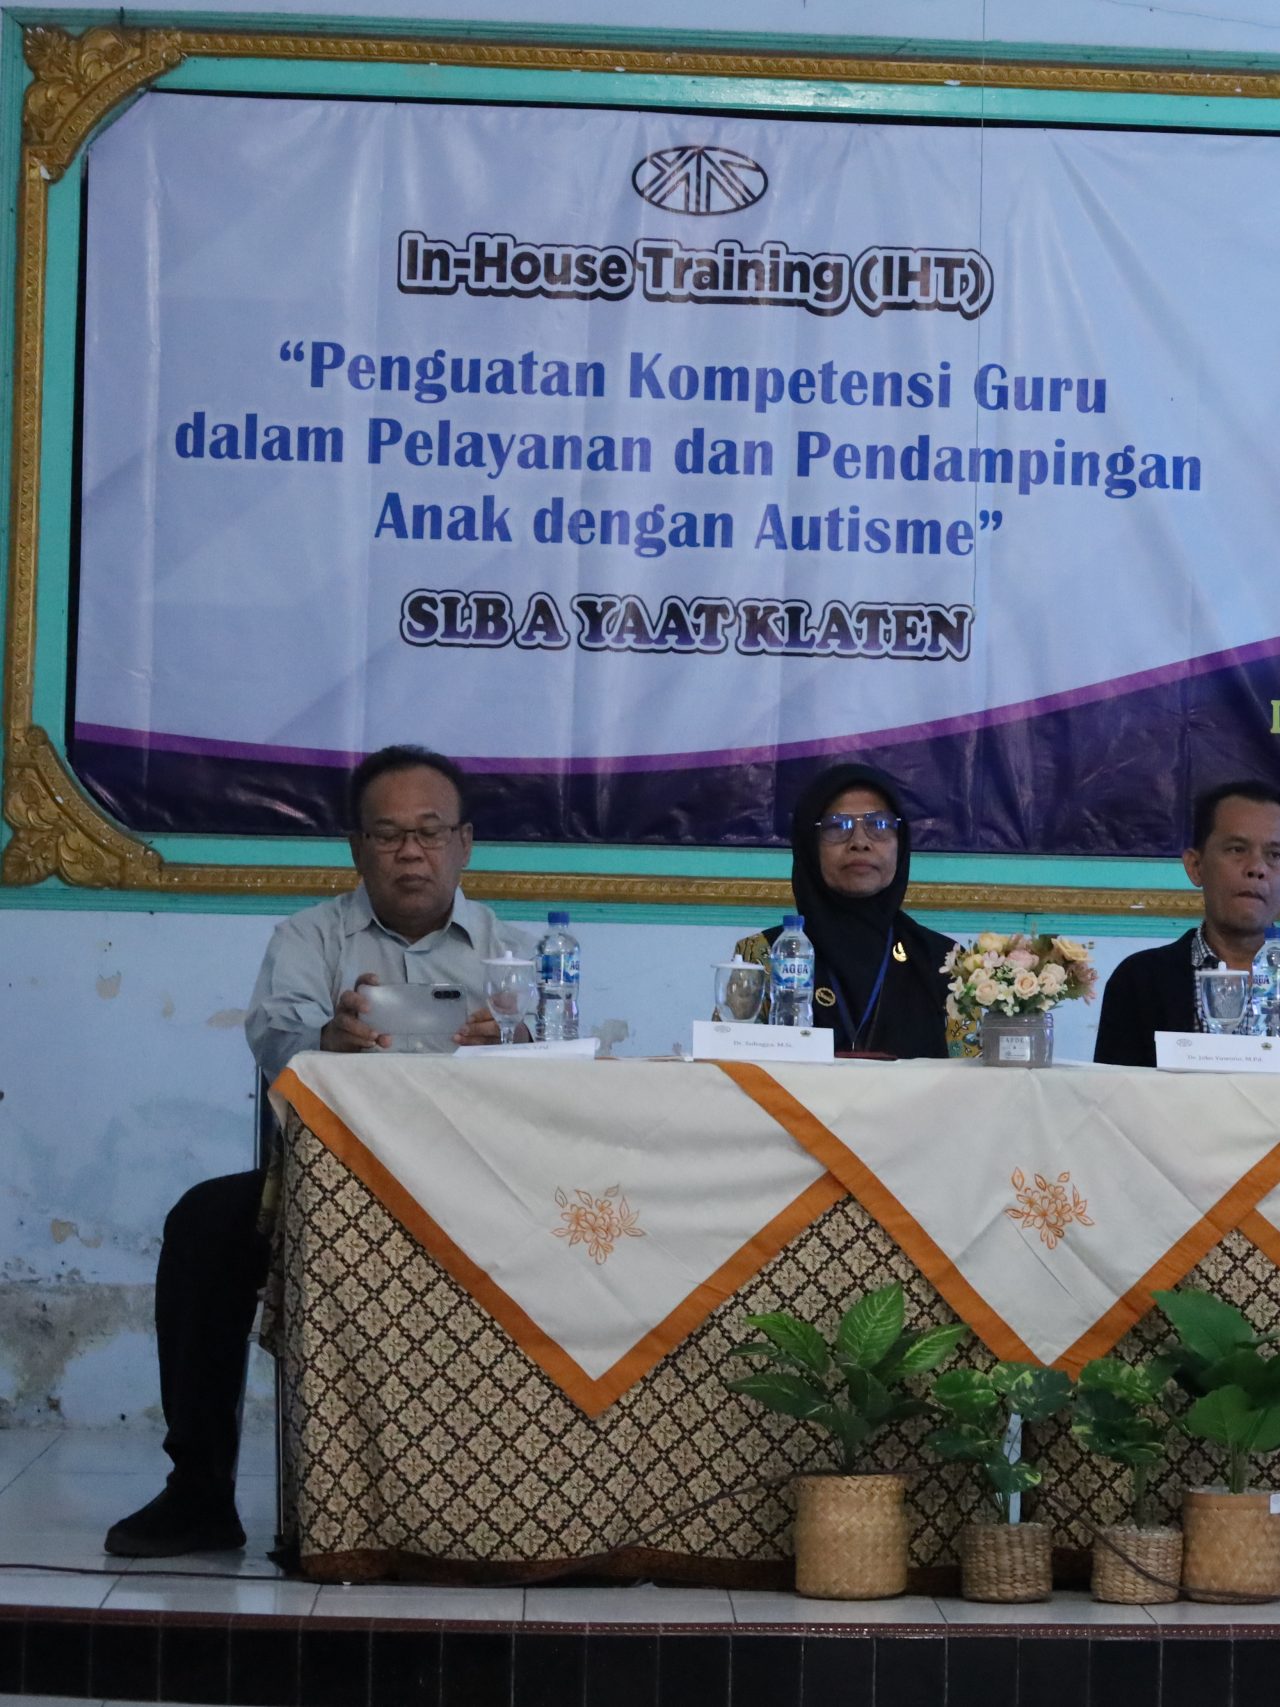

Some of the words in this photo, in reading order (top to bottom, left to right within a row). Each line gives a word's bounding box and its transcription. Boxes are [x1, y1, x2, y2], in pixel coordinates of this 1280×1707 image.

[403, 235, 631, 294] In-House
[640, 243, 848, 302] Training
[857, 249, 985, 312] (IHT)
[279, 340, 606, 404] “Penguatan
[629, 351, 952, 413] Kompetensi
[973, 363, 1107, 414] Guru
[174, 412, 344, 463] dalam
[367, 418, 651, 479] Pelayanan
[674, 428, 774, 477] dan
[796, 430, 1202, 499] Pendampingan
[374, 493, 513, 543] Anak
[532, 497, 734, 558] dengan
[754, 503, 1004, 556] Autisme”
[404, 594, 511, 643] SLB
[519, 597, 567, 645] A
[574, 598, 733, 651] YAAT
[738, 602, 974, 658] KLATEN
[782, 963, 809, 974] AQUA
